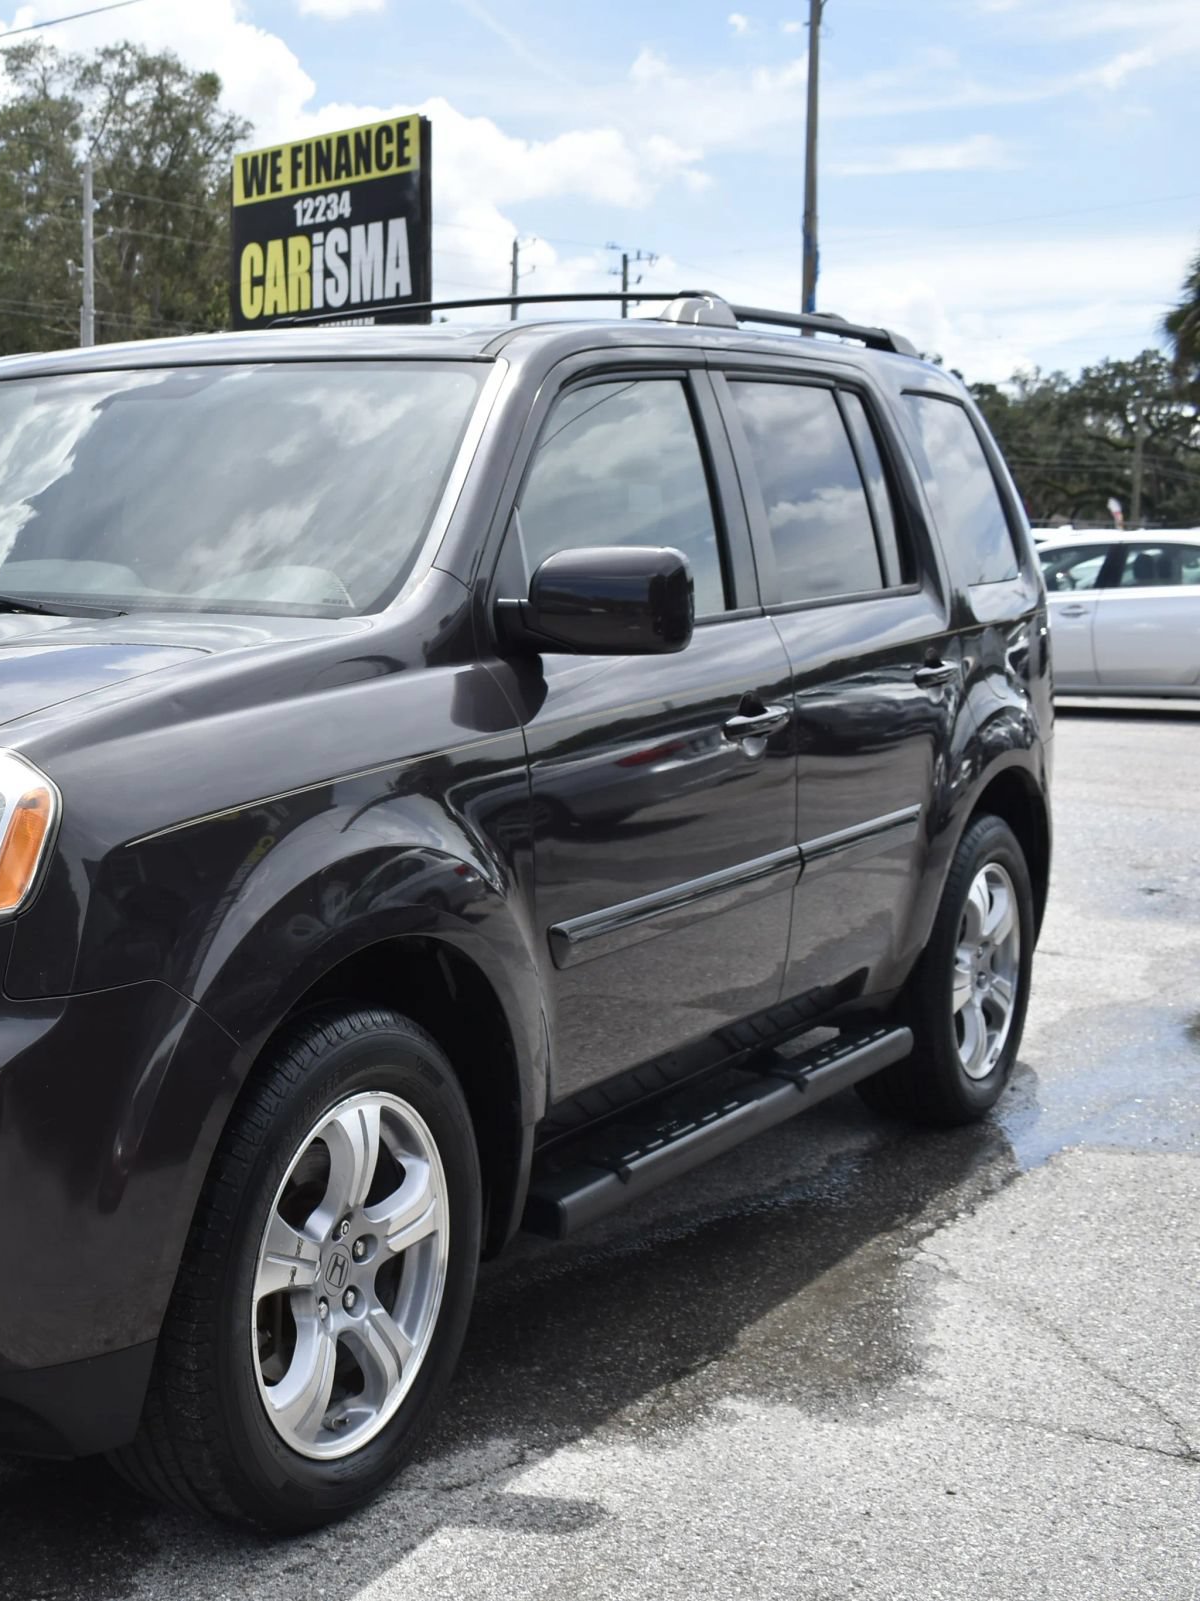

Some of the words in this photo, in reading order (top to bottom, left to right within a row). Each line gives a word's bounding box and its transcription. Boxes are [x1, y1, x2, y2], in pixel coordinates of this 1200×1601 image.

[241, 149, 282, 199] WE
[290, 120, 411, 189] FINANCE
[293, 190, 352, 227] 12234
